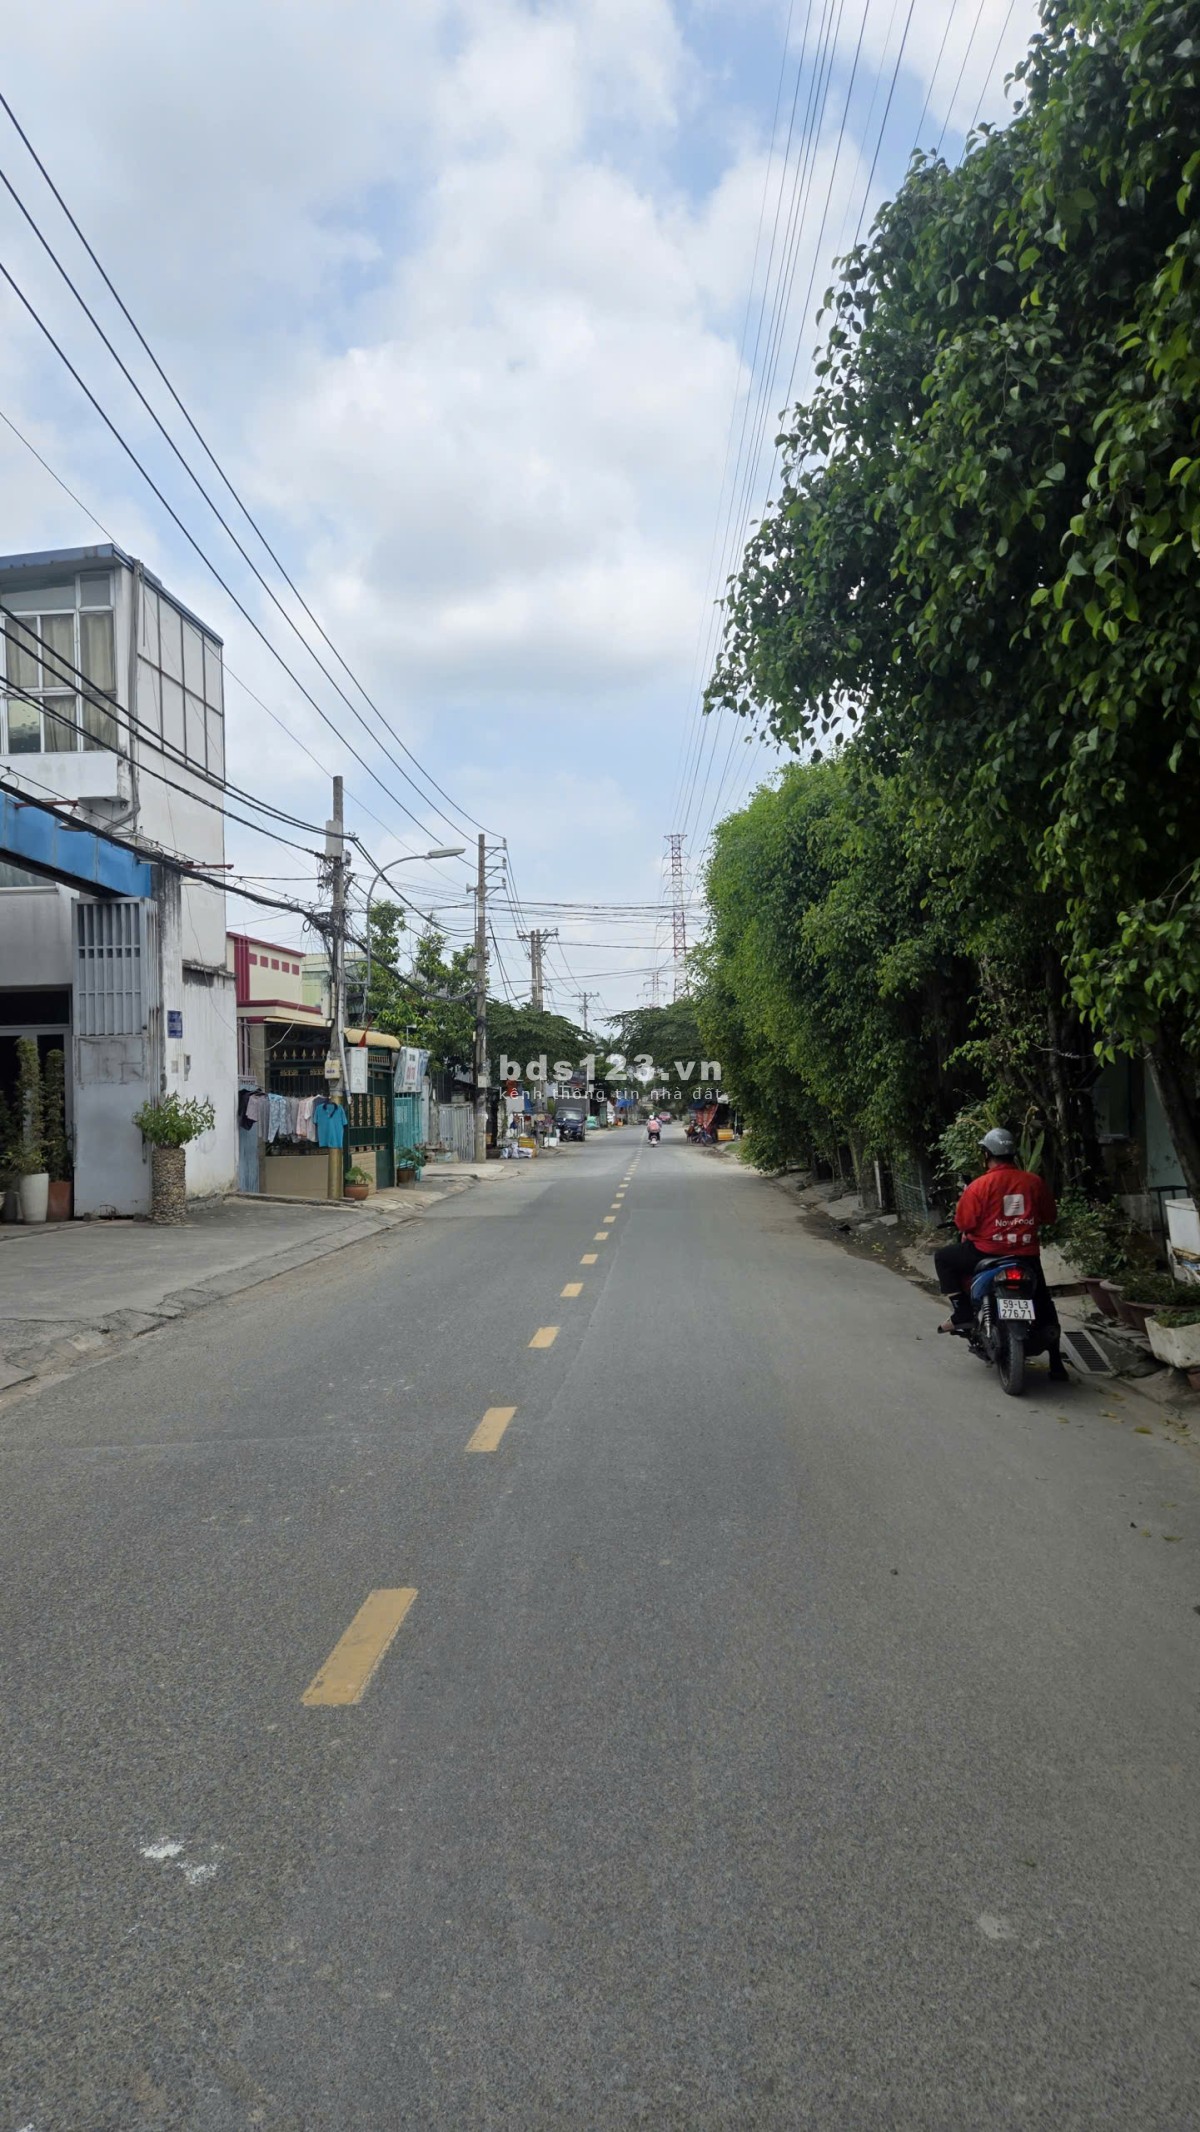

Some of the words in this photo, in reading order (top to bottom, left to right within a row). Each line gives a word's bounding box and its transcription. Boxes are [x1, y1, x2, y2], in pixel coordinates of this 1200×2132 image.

[995, 1217, 1035, 1227] NowFood
[1003, 1299, 1029, 1309] 59-L3
[1002, 1309, 1032, 1319] 276.71
